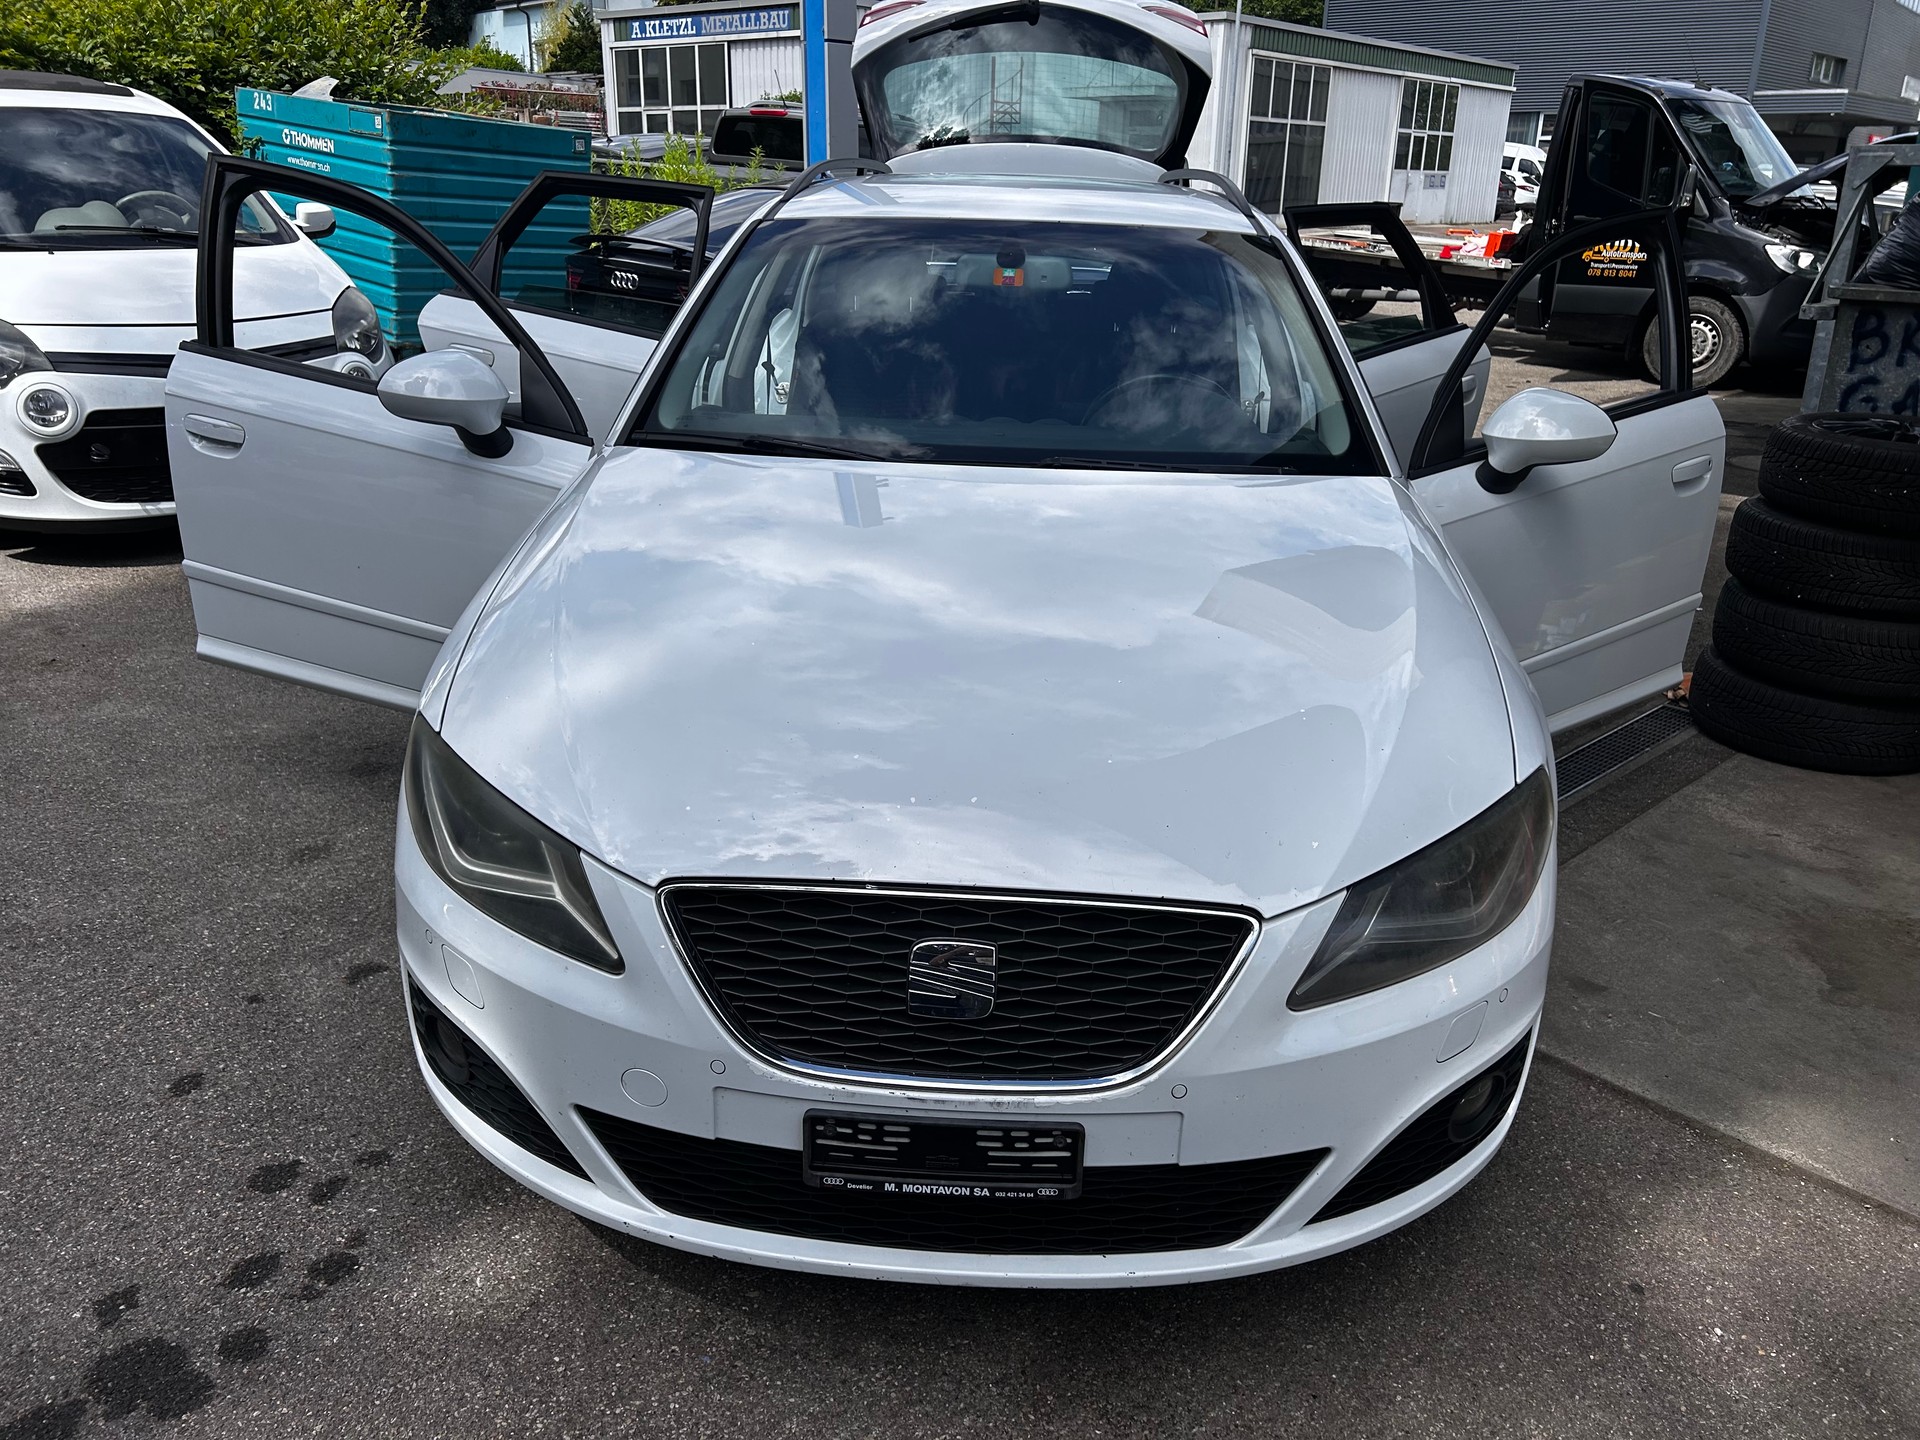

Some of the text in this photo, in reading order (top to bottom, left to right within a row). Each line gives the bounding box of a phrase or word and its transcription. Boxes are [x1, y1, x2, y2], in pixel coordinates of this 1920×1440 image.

[631, 10, 789, 39] A.KLETZL METALLBAU
[253, 91, 273, 111] 243
[290, 129, 335, 153] THOMMEN
[1587, 268, 1637, 278] 078 813 8041
[884, 1182, 899, 1192] M.
[902, 1184, 970, 1196] MONTAVON
[973, 1187, 990, 1197] SA
